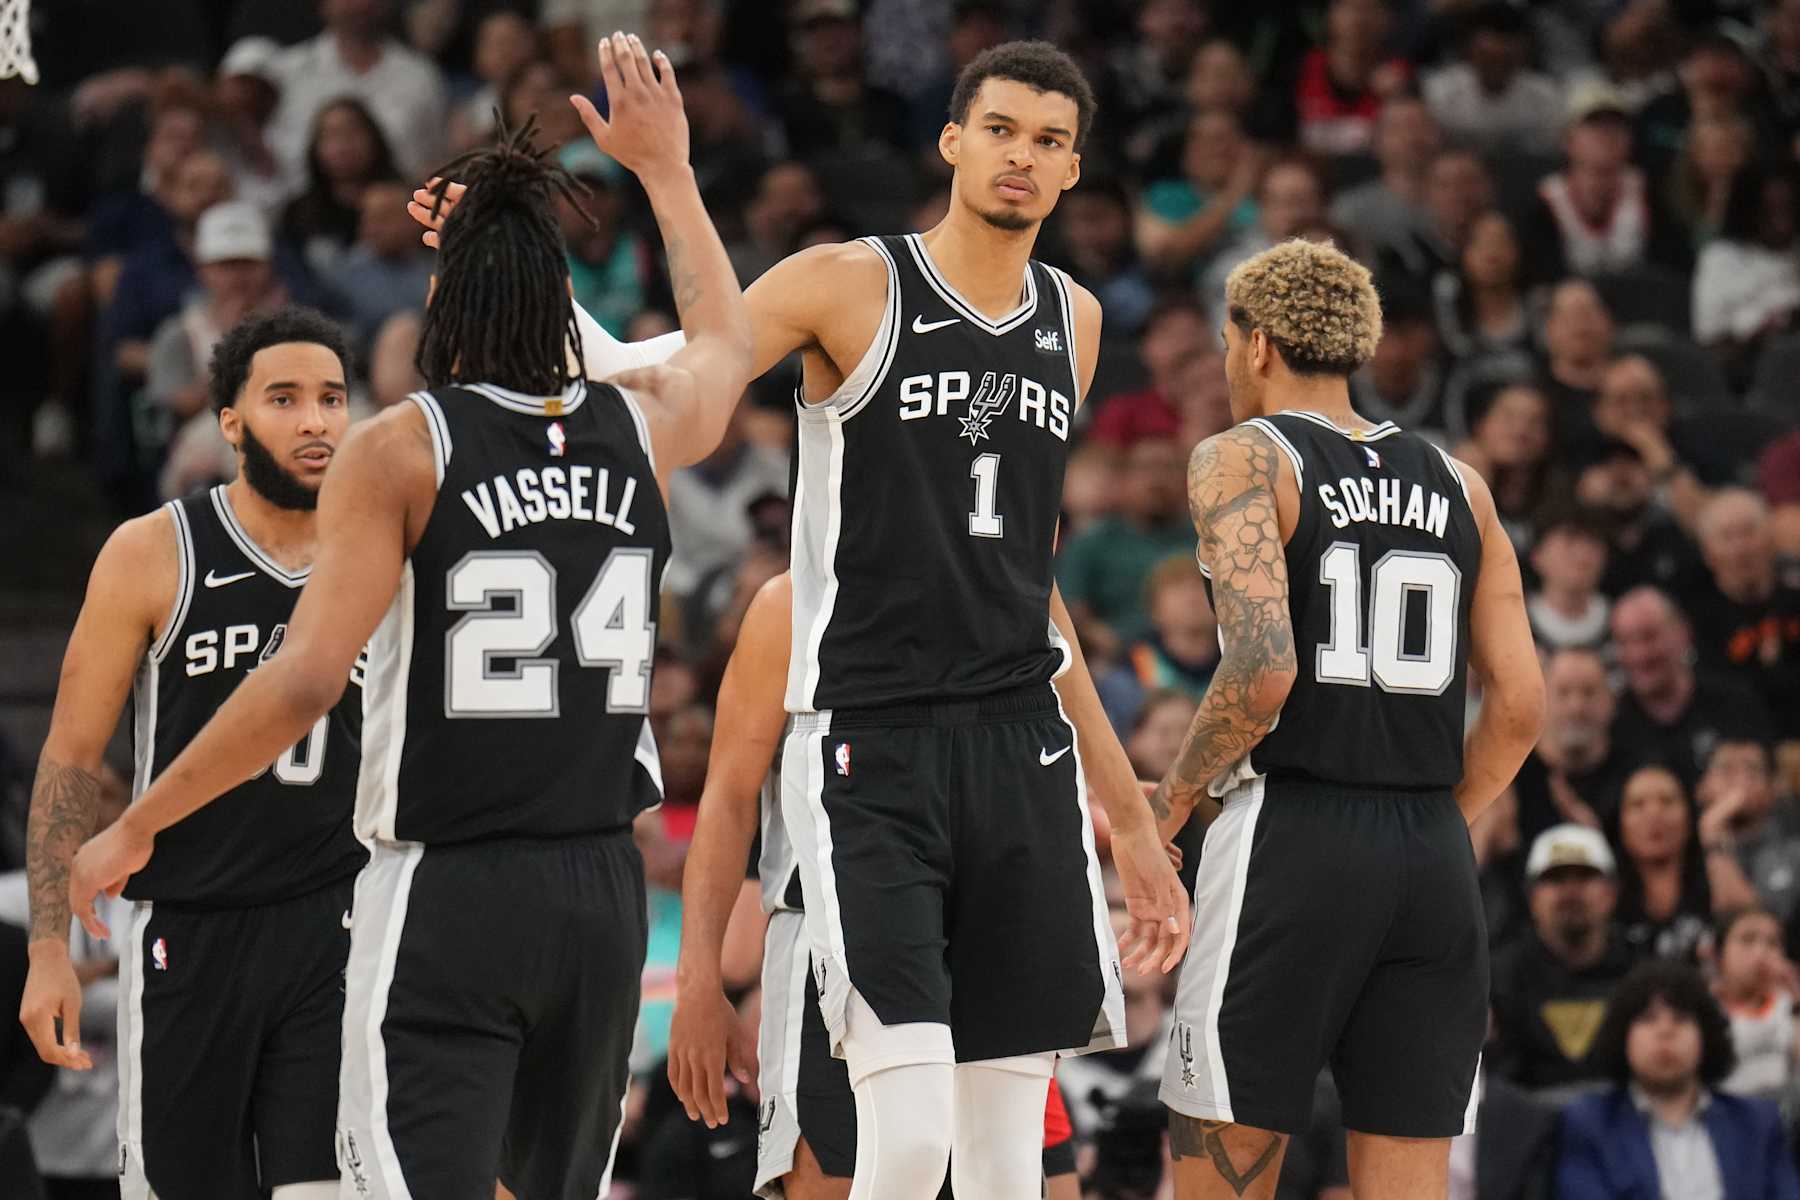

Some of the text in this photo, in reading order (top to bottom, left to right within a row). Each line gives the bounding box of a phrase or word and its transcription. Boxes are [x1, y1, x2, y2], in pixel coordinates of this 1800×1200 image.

[899, 371, 1070, 447] SPURS
[461, 465, 638, 539] VASSELL
[968, 452, 1004, 539] 1
[1318, 476, 1450, 539] SOCHAN
[444, 547, 656, 718] 24
[1315, 540, 1463, 697] 10
